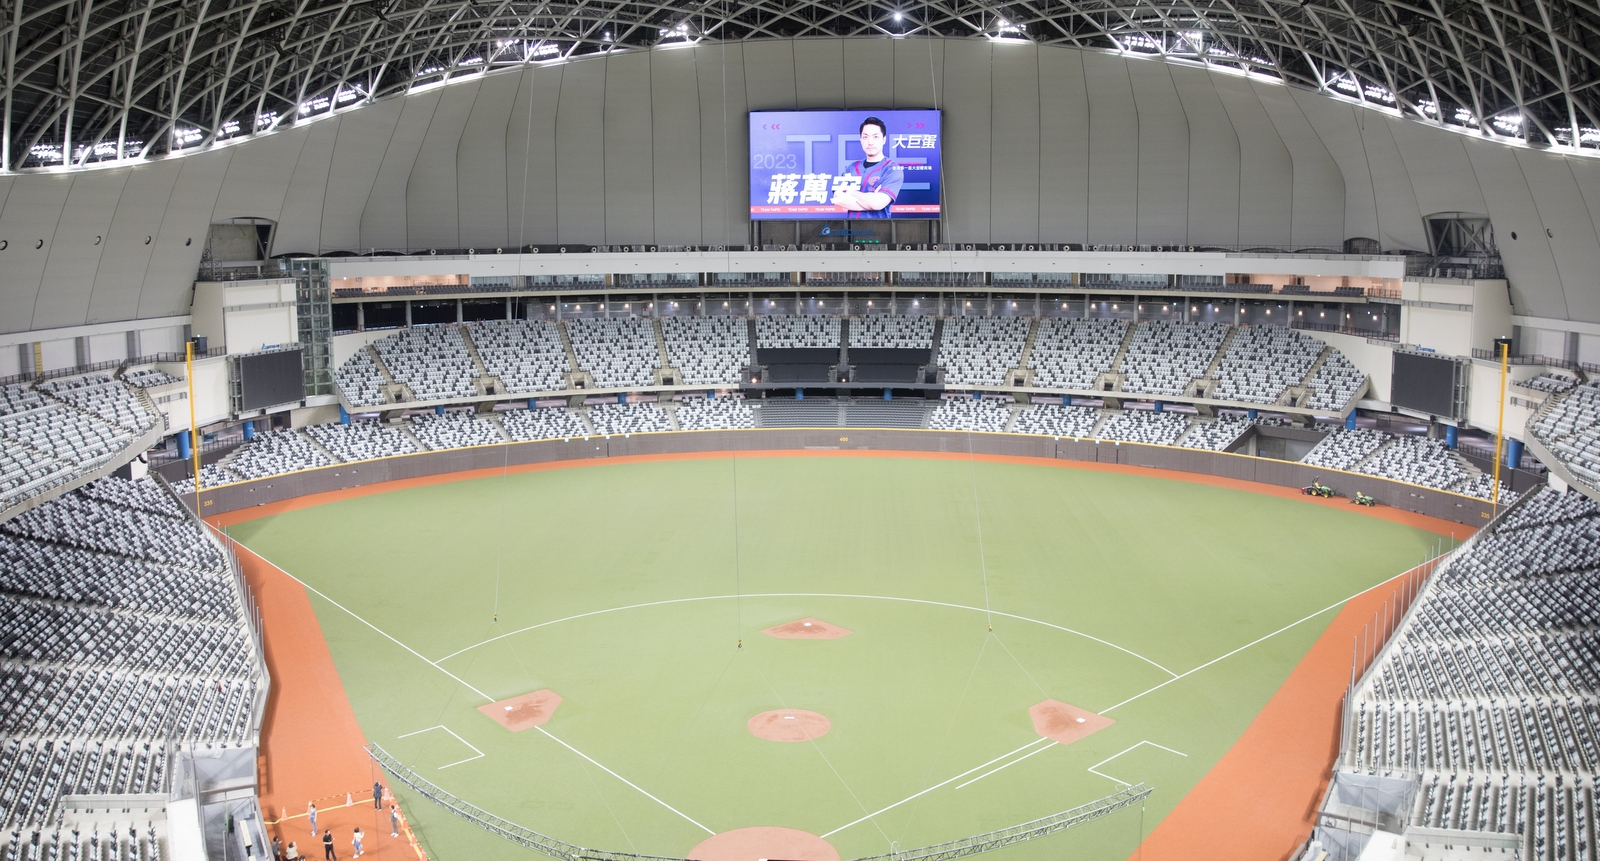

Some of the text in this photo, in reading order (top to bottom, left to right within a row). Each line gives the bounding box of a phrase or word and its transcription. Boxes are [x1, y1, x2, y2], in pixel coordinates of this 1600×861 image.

[891, 134, 937, 149] 大巨蛋
[753, 154, 797, 170] 2023
[767, 172, 862, 204] 蔣萬安
[203, 499, 214, 507] 335
[1480, 511, 1490, 519] 335
